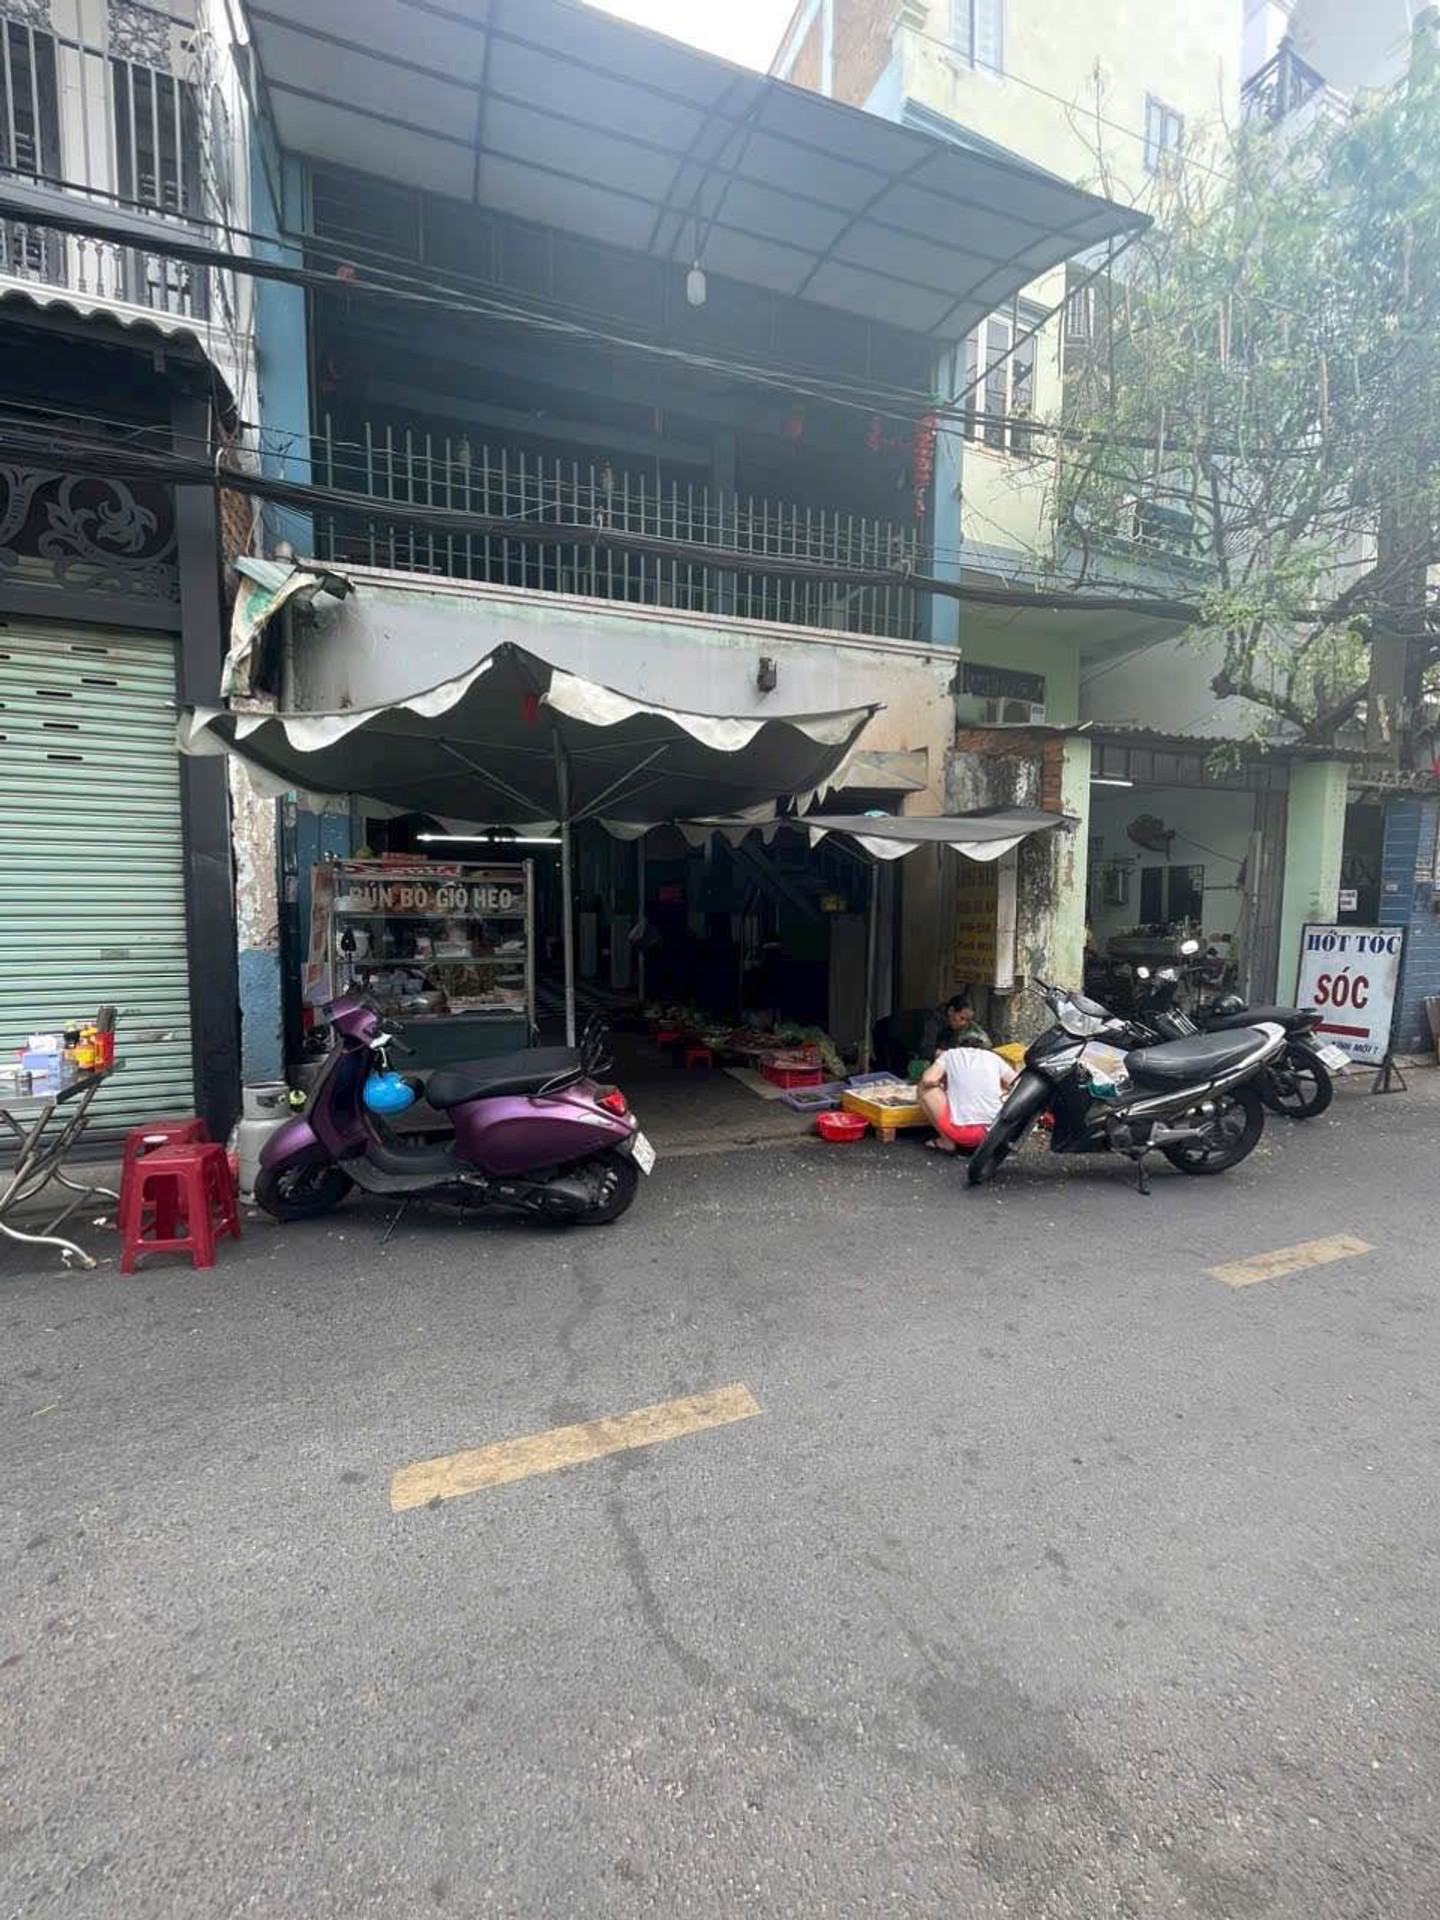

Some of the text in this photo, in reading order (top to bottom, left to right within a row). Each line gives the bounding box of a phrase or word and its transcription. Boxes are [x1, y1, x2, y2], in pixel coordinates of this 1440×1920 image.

[473, 888, 512, 909] HEO
[1356, 930, 1401, 955] TÓC
[1314, 966, 1369, 1009] SÓC
